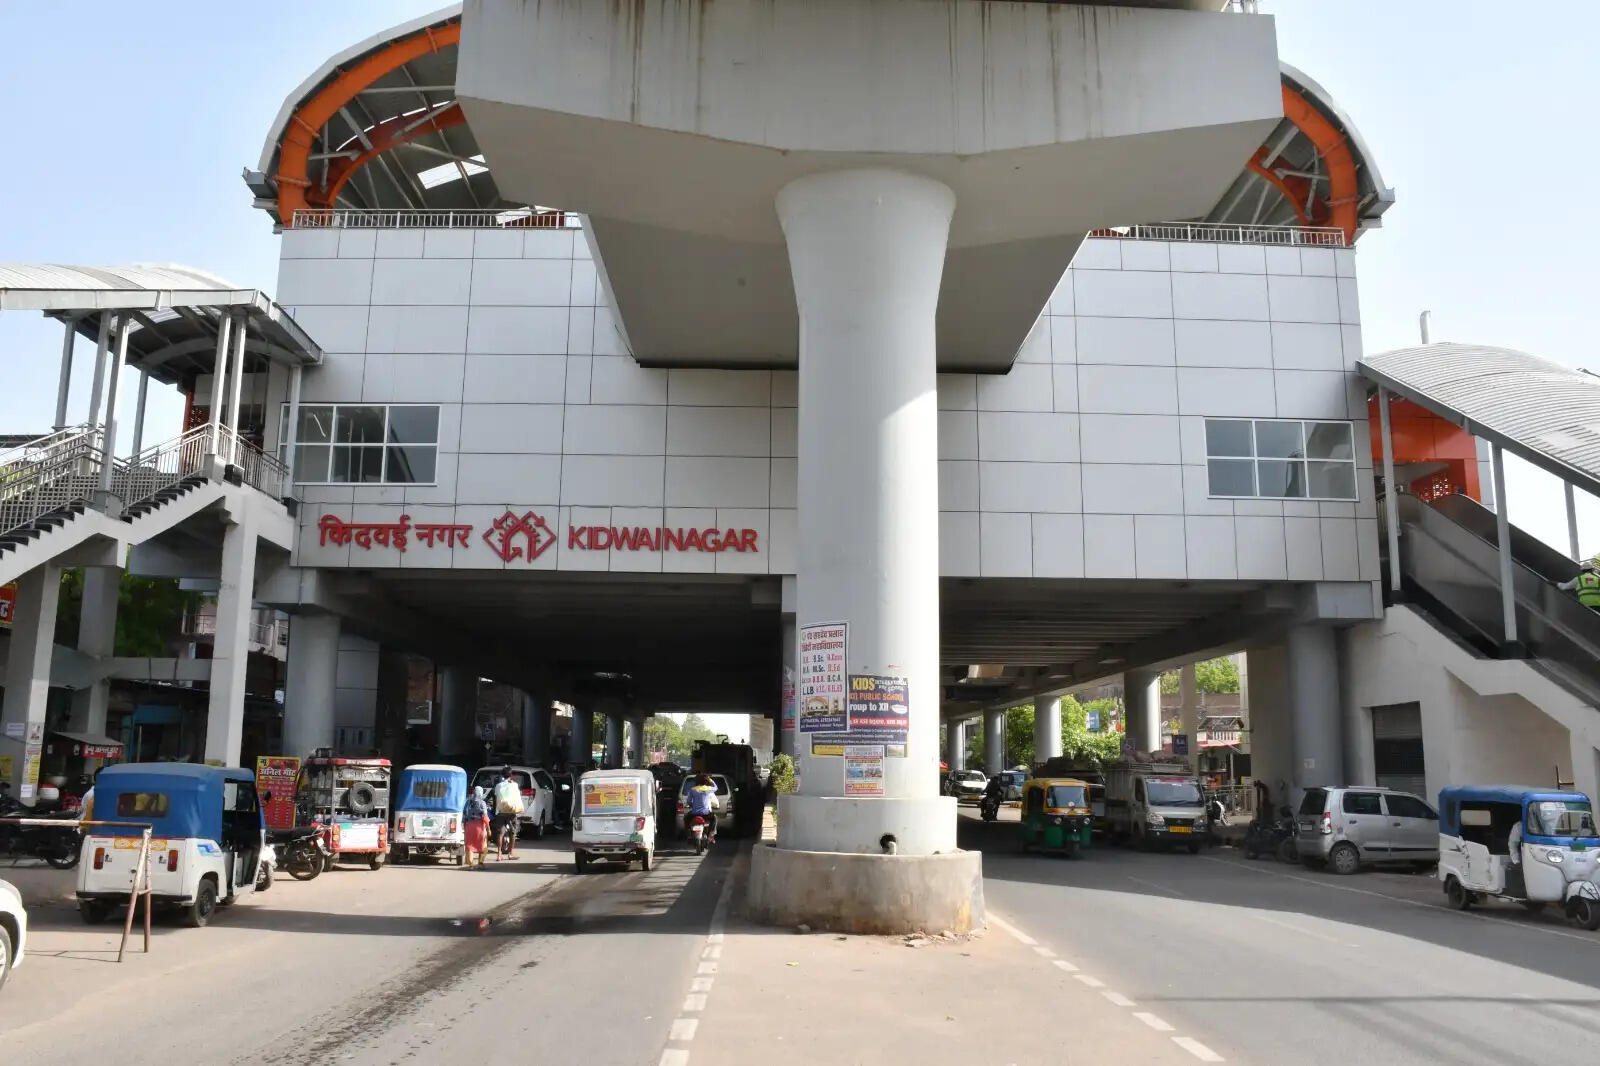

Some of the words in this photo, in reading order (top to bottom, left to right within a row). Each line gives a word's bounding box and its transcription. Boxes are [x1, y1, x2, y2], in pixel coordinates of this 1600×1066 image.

[318, 514, 411, 552] किदवई
[414, 524, 473, 548] नगर
[853, 677, 875, 690] KIDS
[859, 692, 881, 701] PUBLIC
[850, 703, 867, 712] roup
[869, 702, 877, 711] to
